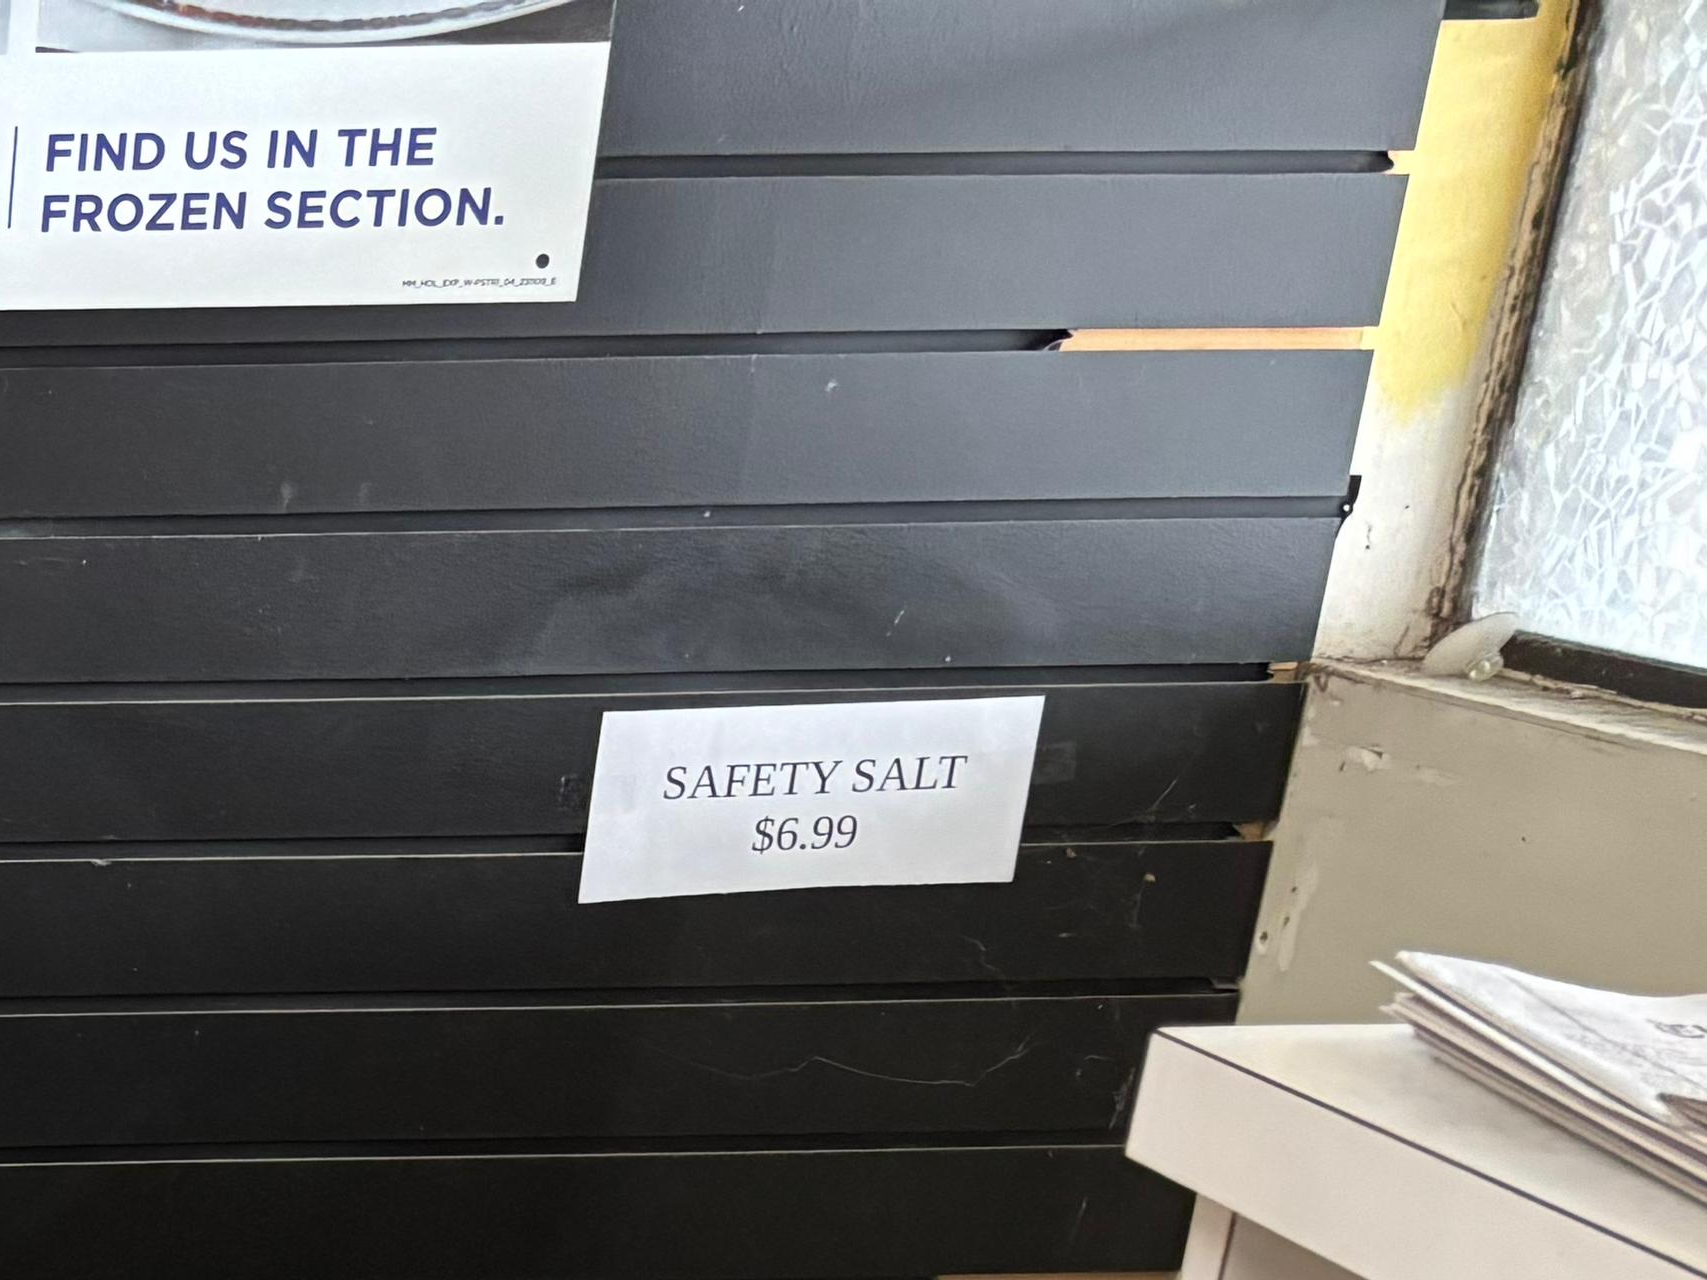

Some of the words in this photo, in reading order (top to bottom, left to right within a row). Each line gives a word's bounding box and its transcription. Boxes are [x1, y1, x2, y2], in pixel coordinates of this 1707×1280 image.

[45, 132, 165, 172] FIND
[185, 131, 248, 170] US
[267, 128, 318, 169] IN
[337, 126, 437, 167] THE
[41, 192, 247, 233] FROZEN
[264, 187, 504, 229] SECTION.
[662, 759, 843, 801] SAFETY
[851, 754, 968, 792] SALT
[751, 815, 858, 853] $6.99
